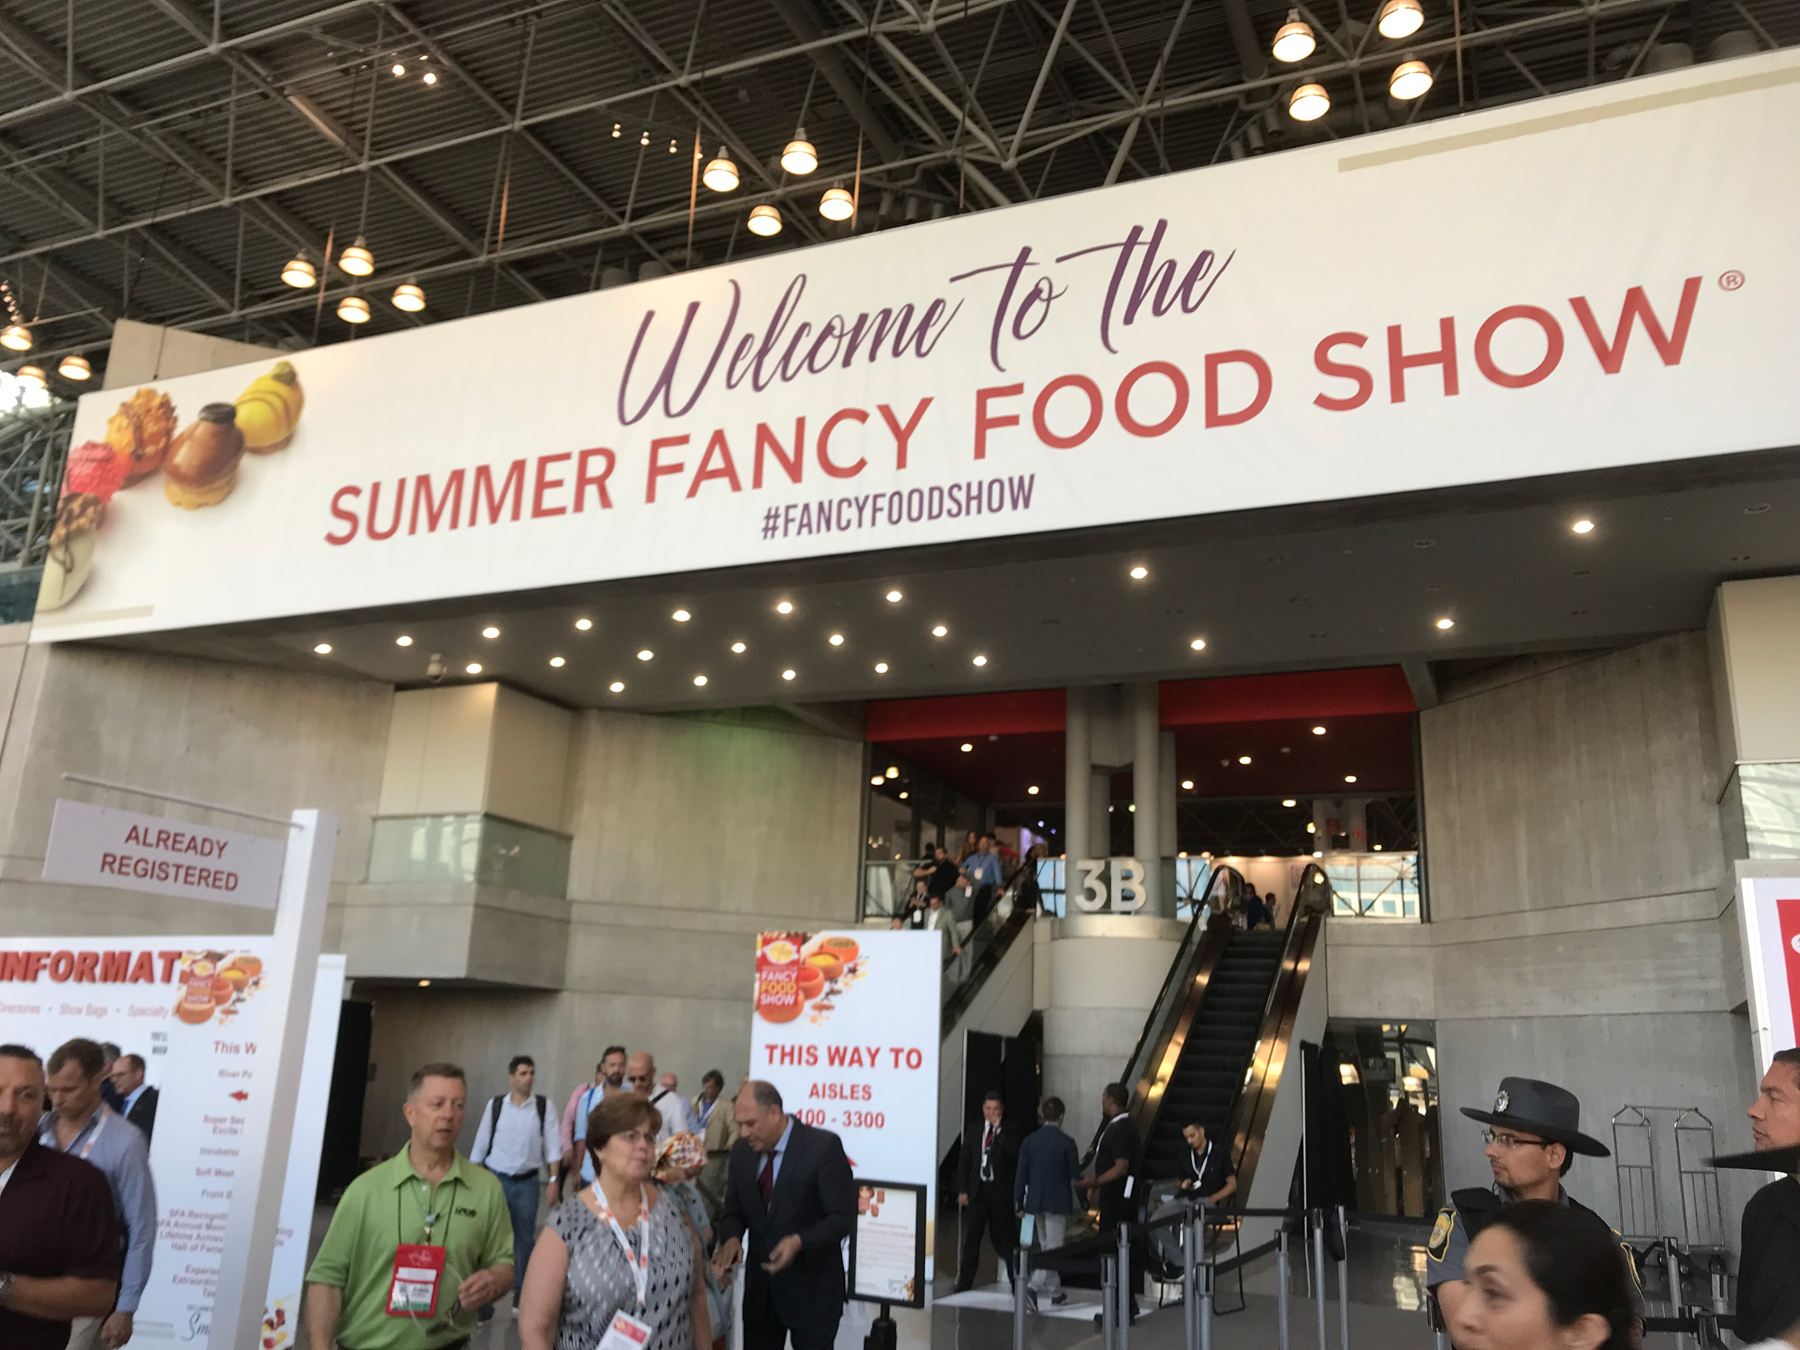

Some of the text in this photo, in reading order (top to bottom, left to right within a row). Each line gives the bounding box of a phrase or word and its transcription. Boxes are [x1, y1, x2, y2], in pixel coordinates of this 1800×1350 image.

[618, 218, 1236, 426] Welcome to the
[324, 446, 617, 546] SUMMER
[644, 396, 934, 504] FANCY
[973, 349, 1273, 460] FOOD
[762, 473, 1036, 541] #FANCYFOODSHOW
[124, 824, 228, 859] ALREADY
[100, 852, 238, 892] REGISTERED
[1075, 858, 1146, 911] 3B
[760, 971, 798, 981] FANCY
[760, 981, 797, 994] FOOD
[760, 993, 796, 1006] SHOW
[214, 1041, 240, 1055] This
[764, 1044, 923, 1070] THIS WAY TO
[808, 1083, 872, 1101] AISLES
[842, 1111, 885, 1129] 3300
